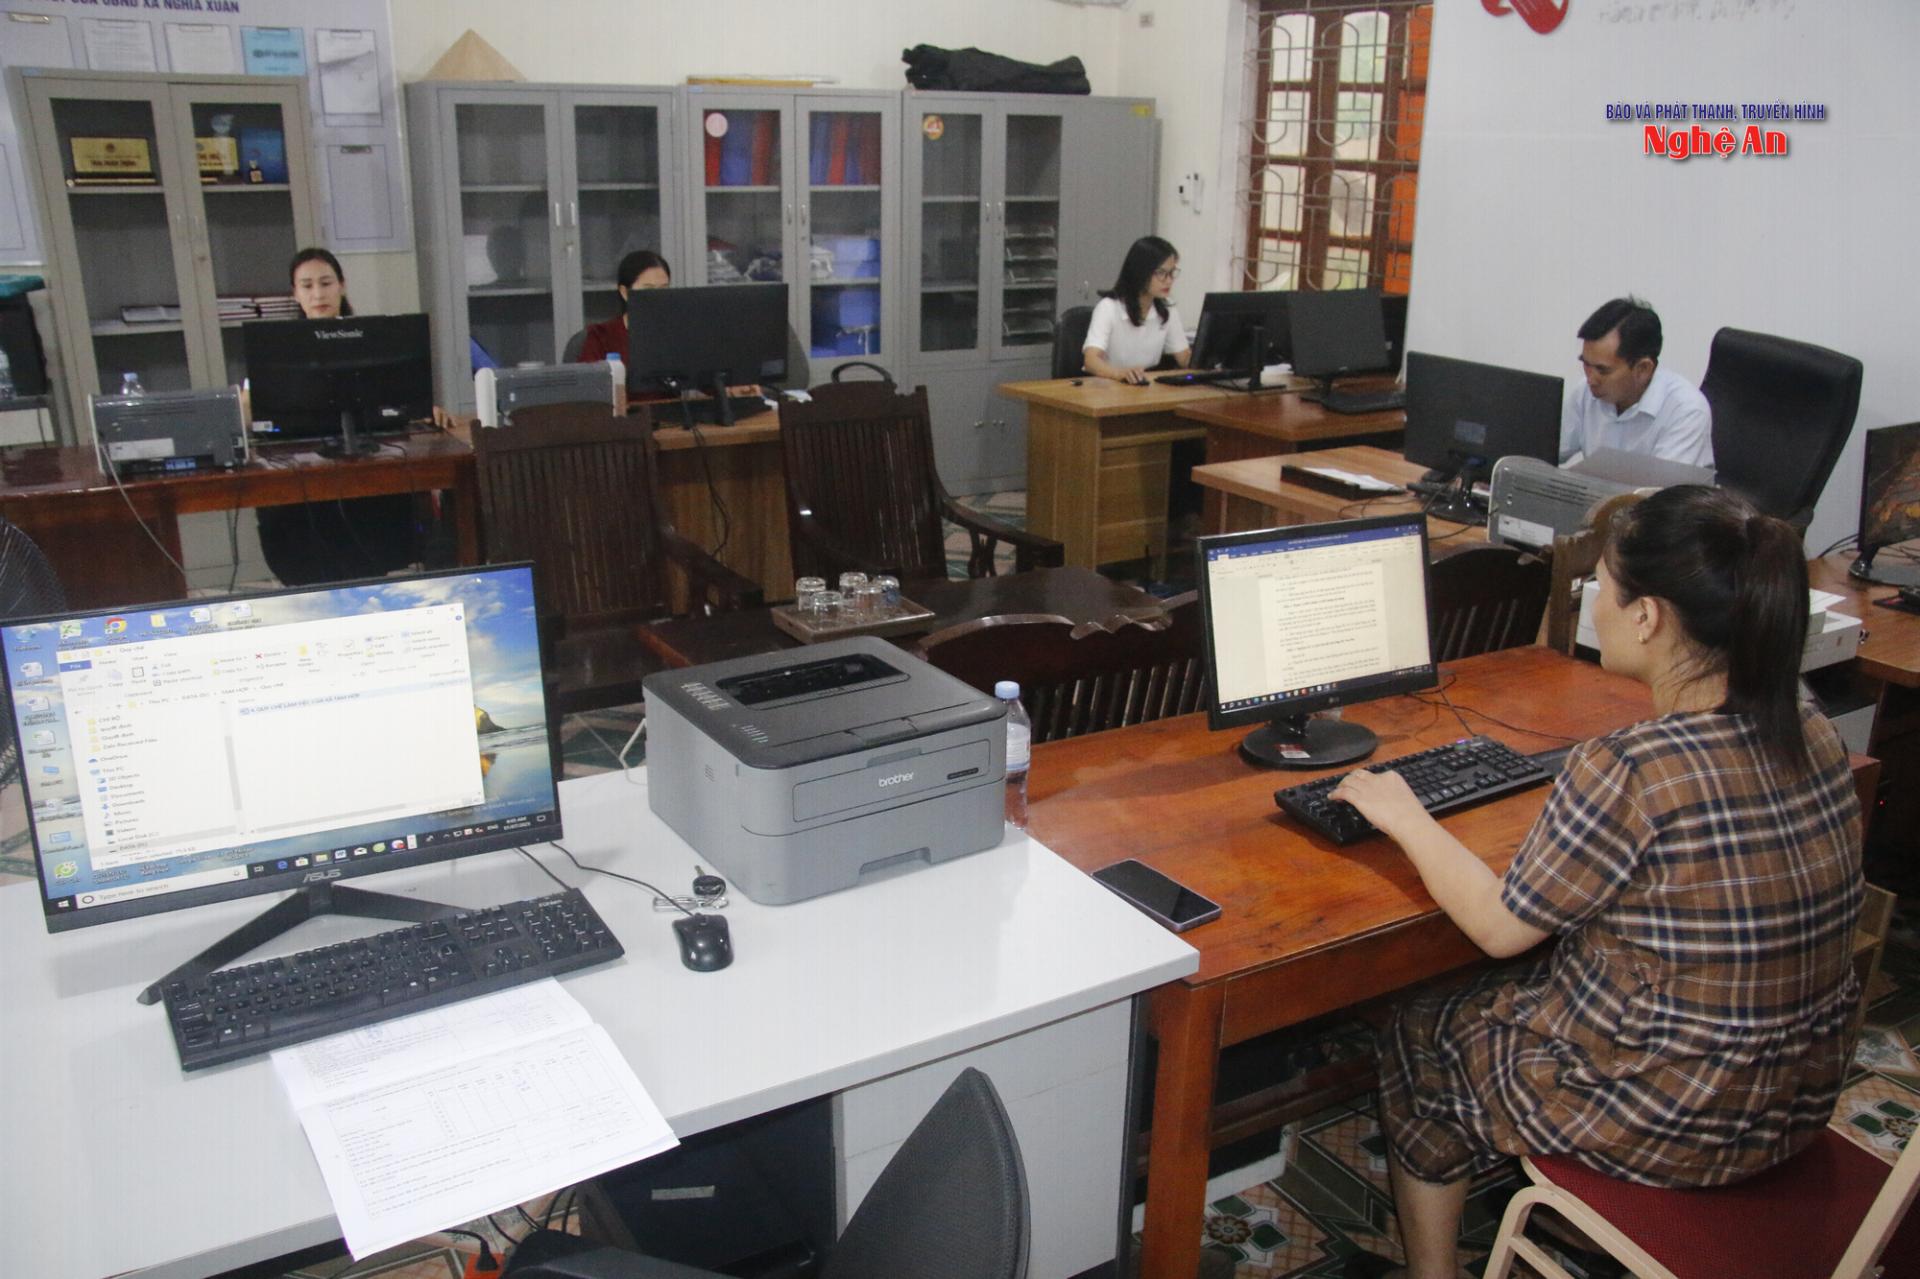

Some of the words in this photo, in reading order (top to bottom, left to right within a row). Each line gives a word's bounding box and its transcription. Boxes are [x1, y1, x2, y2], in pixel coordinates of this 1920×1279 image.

[314, 329, 365, 340] ViewSonic
[878, 771, 914, 788] brother
[303, 869, 342, 883] ASUS
